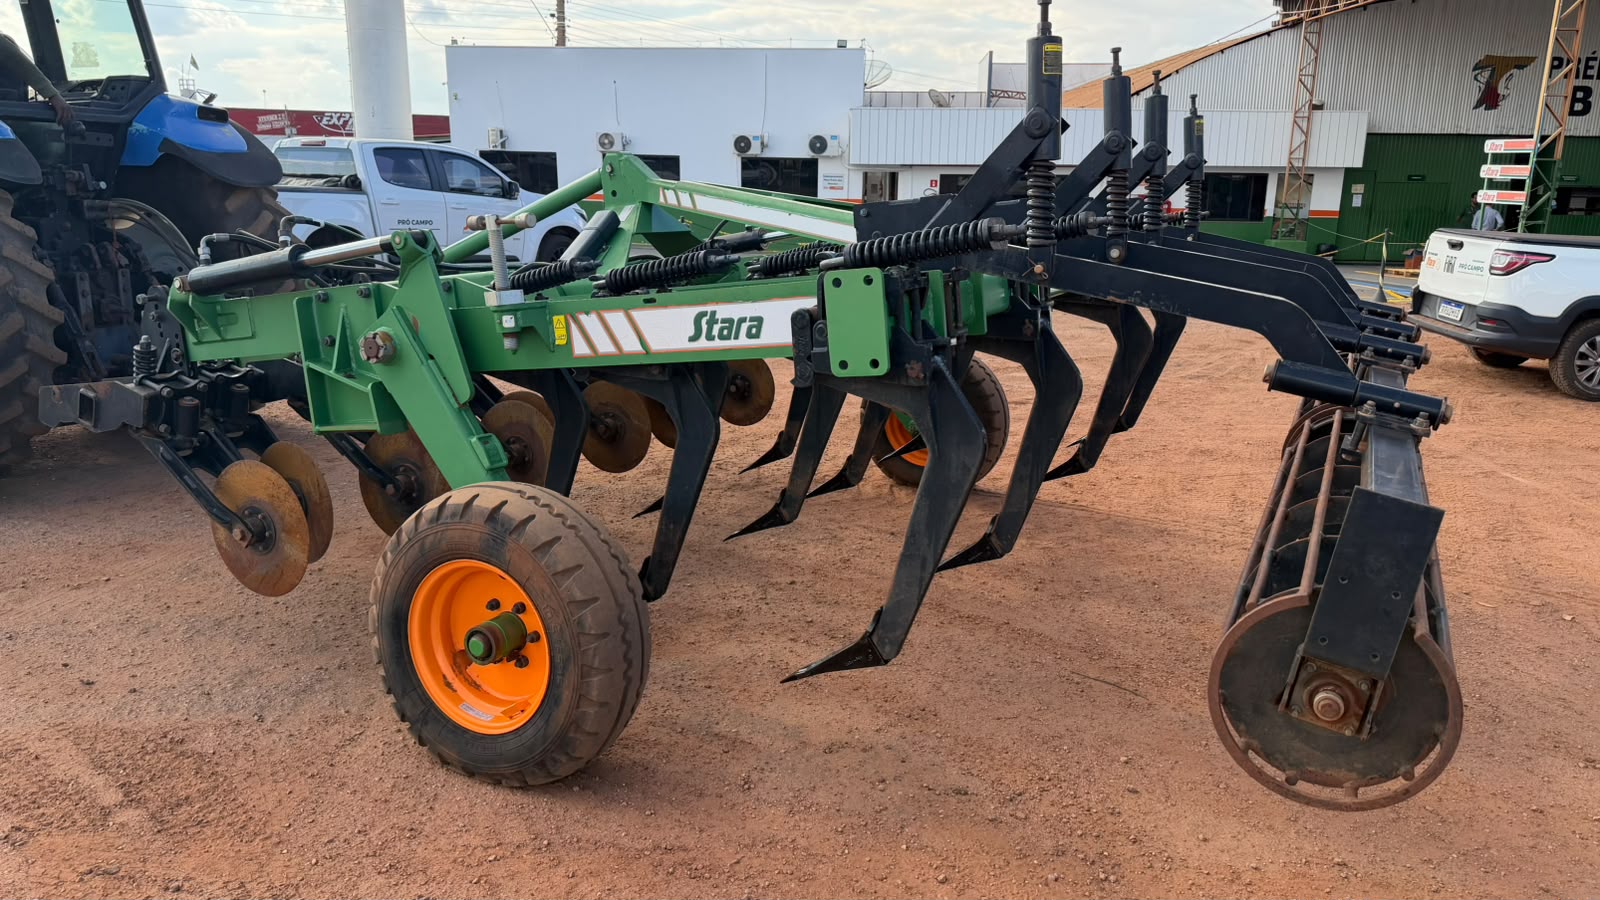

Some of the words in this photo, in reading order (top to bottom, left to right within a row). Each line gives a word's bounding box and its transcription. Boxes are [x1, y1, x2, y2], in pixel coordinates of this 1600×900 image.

[1549, 51, 1600, 80] PRÉ
[322, 113, 354, 125] EXP
[1481, 192, 1495, 201] Stara
[1467, 264, 1485, 272] CAMPO
[687, 310, 764, 343] Stara
